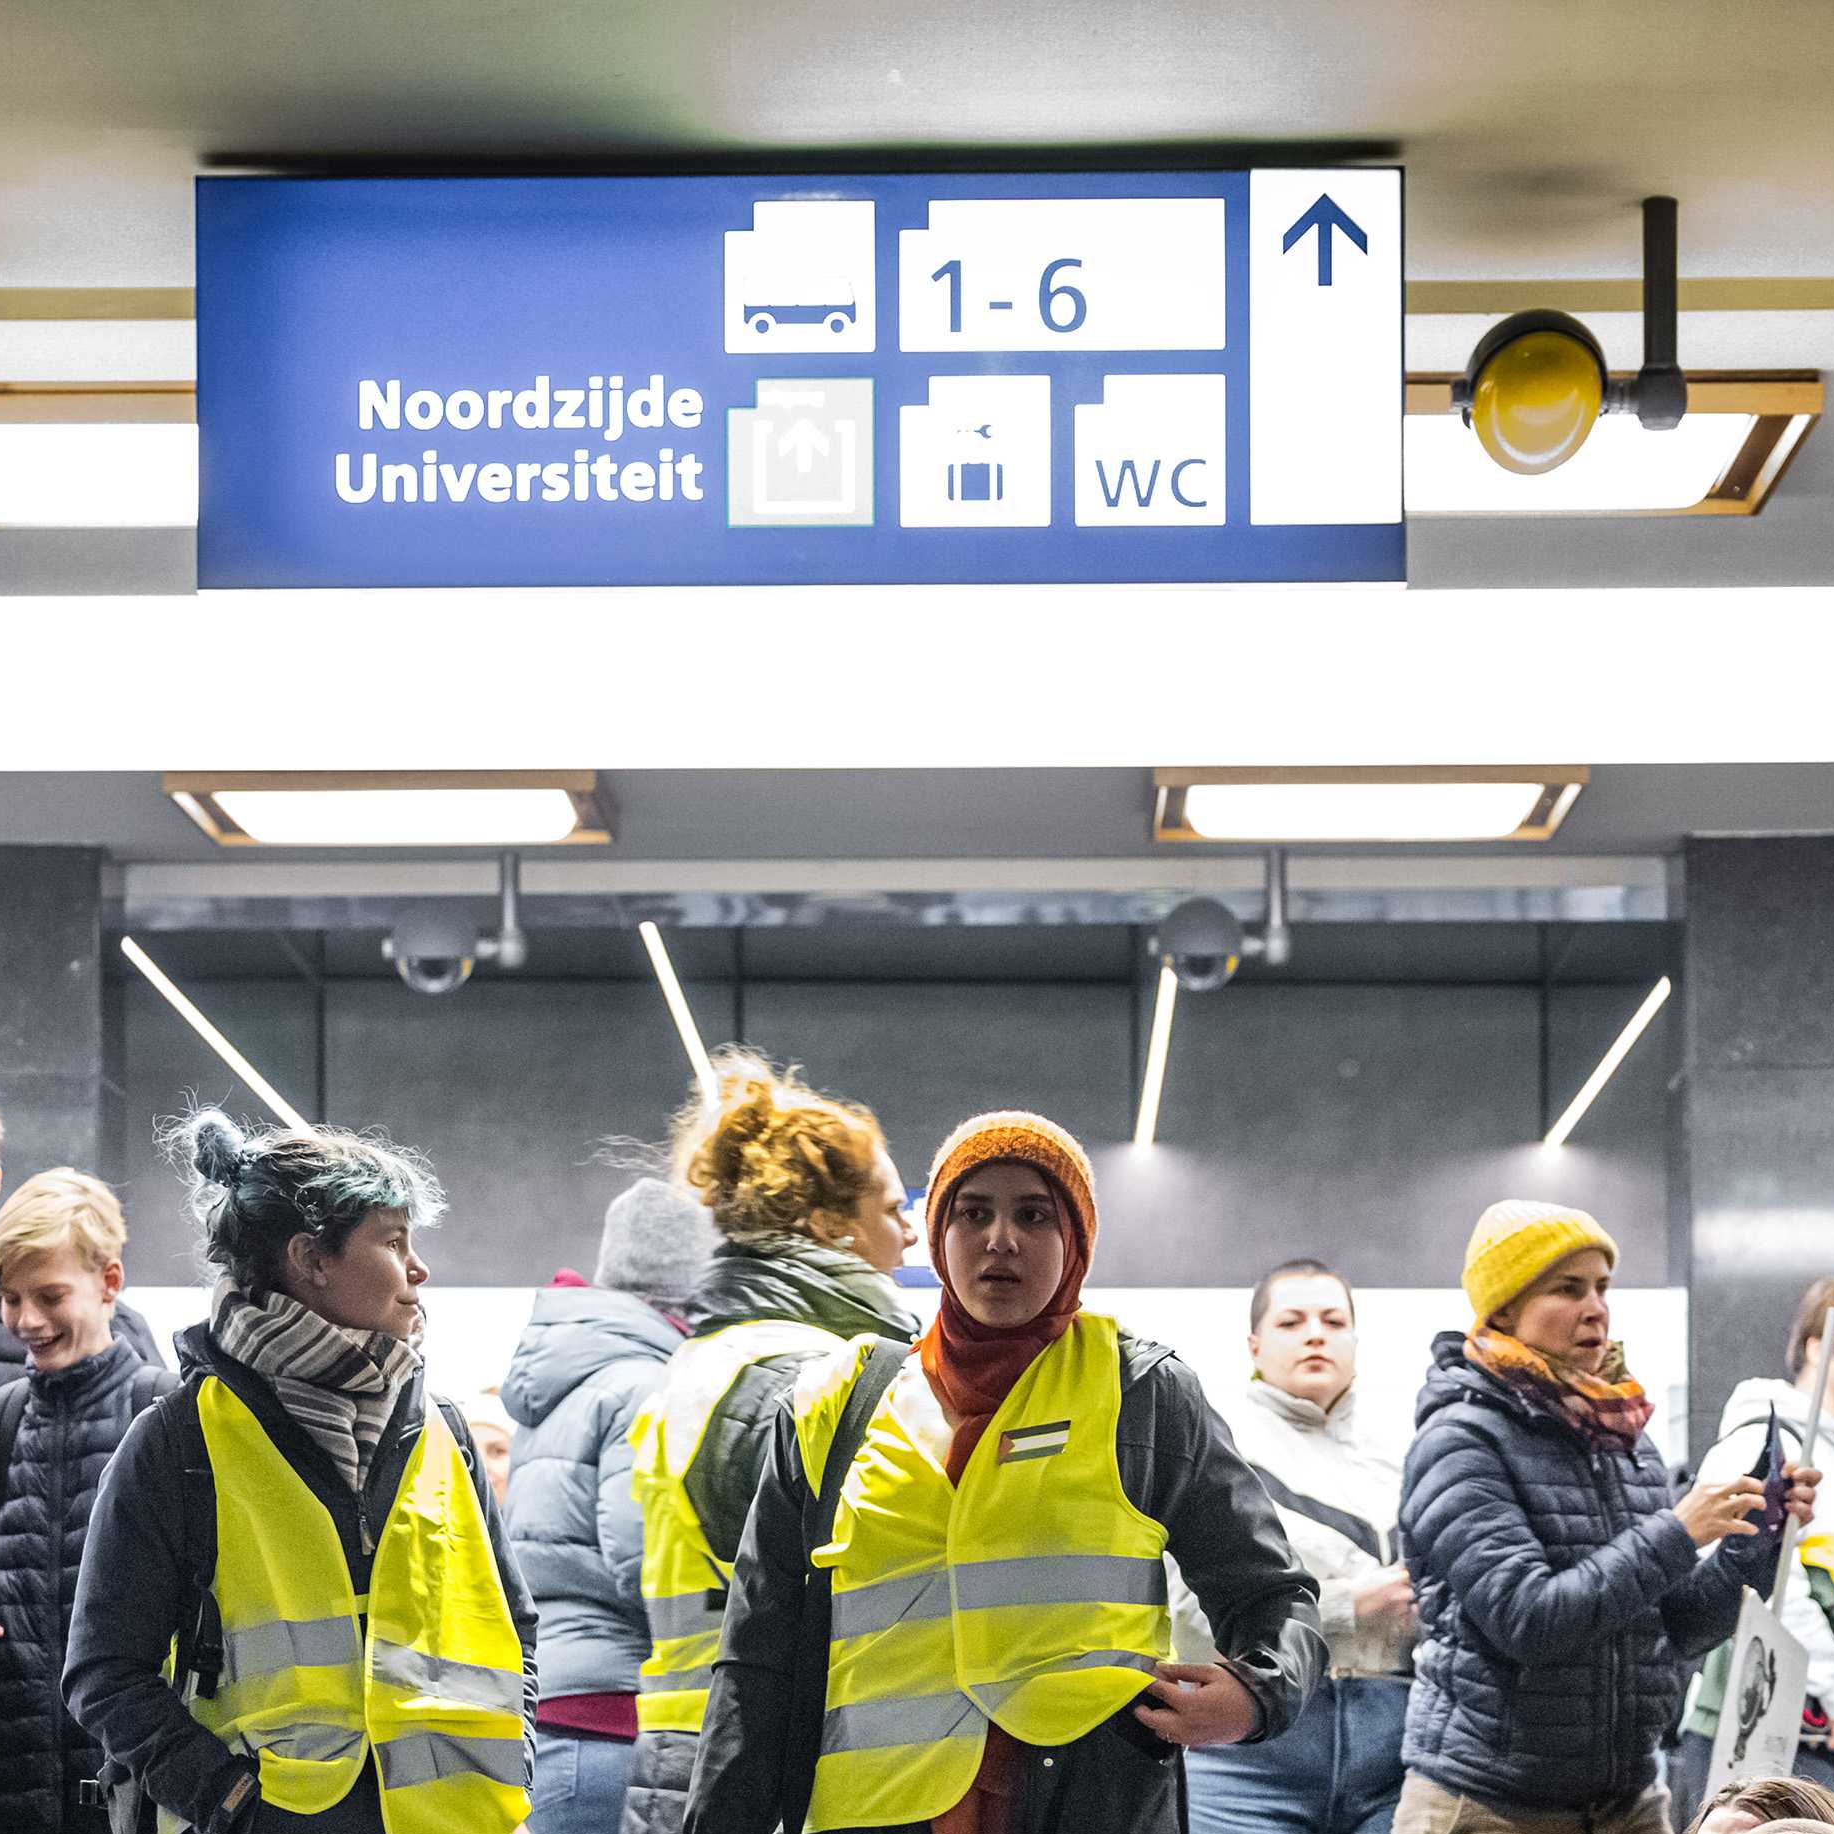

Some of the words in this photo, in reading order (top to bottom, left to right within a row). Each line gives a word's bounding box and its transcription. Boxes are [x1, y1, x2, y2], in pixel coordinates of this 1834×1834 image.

[357, 374, 704, 441] Noordzijde
[334, 448, 704, 504] Universiteit
[1094, 457, 1208, 507] WC
